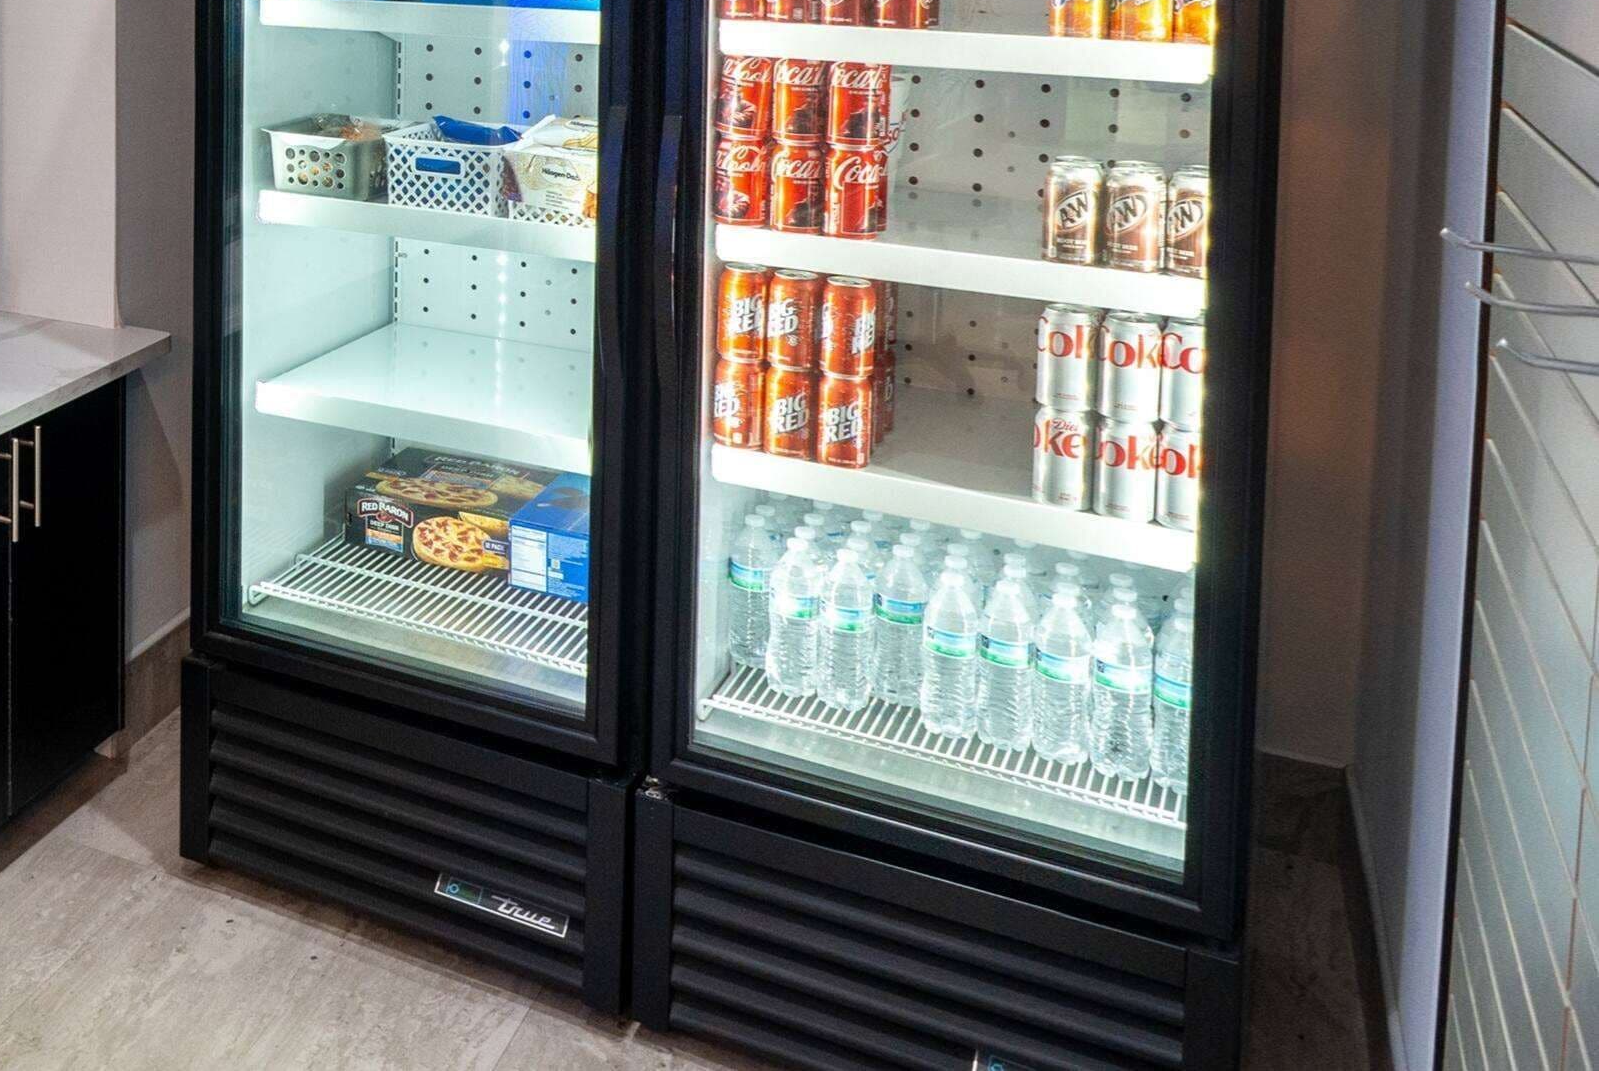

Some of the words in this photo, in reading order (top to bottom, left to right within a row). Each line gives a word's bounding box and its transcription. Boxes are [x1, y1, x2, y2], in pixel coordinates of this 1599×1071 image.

[1162, 332, 1205, 374] Co
[776, 392, 806, 413] BIG
[826, 400, 861, 422] BIG
[774, 409, 809, 434] RED
[825, 419, 863, 443] RED
[361, 501, 378, 512] RED
[378, 501, 409, 521] BARON
